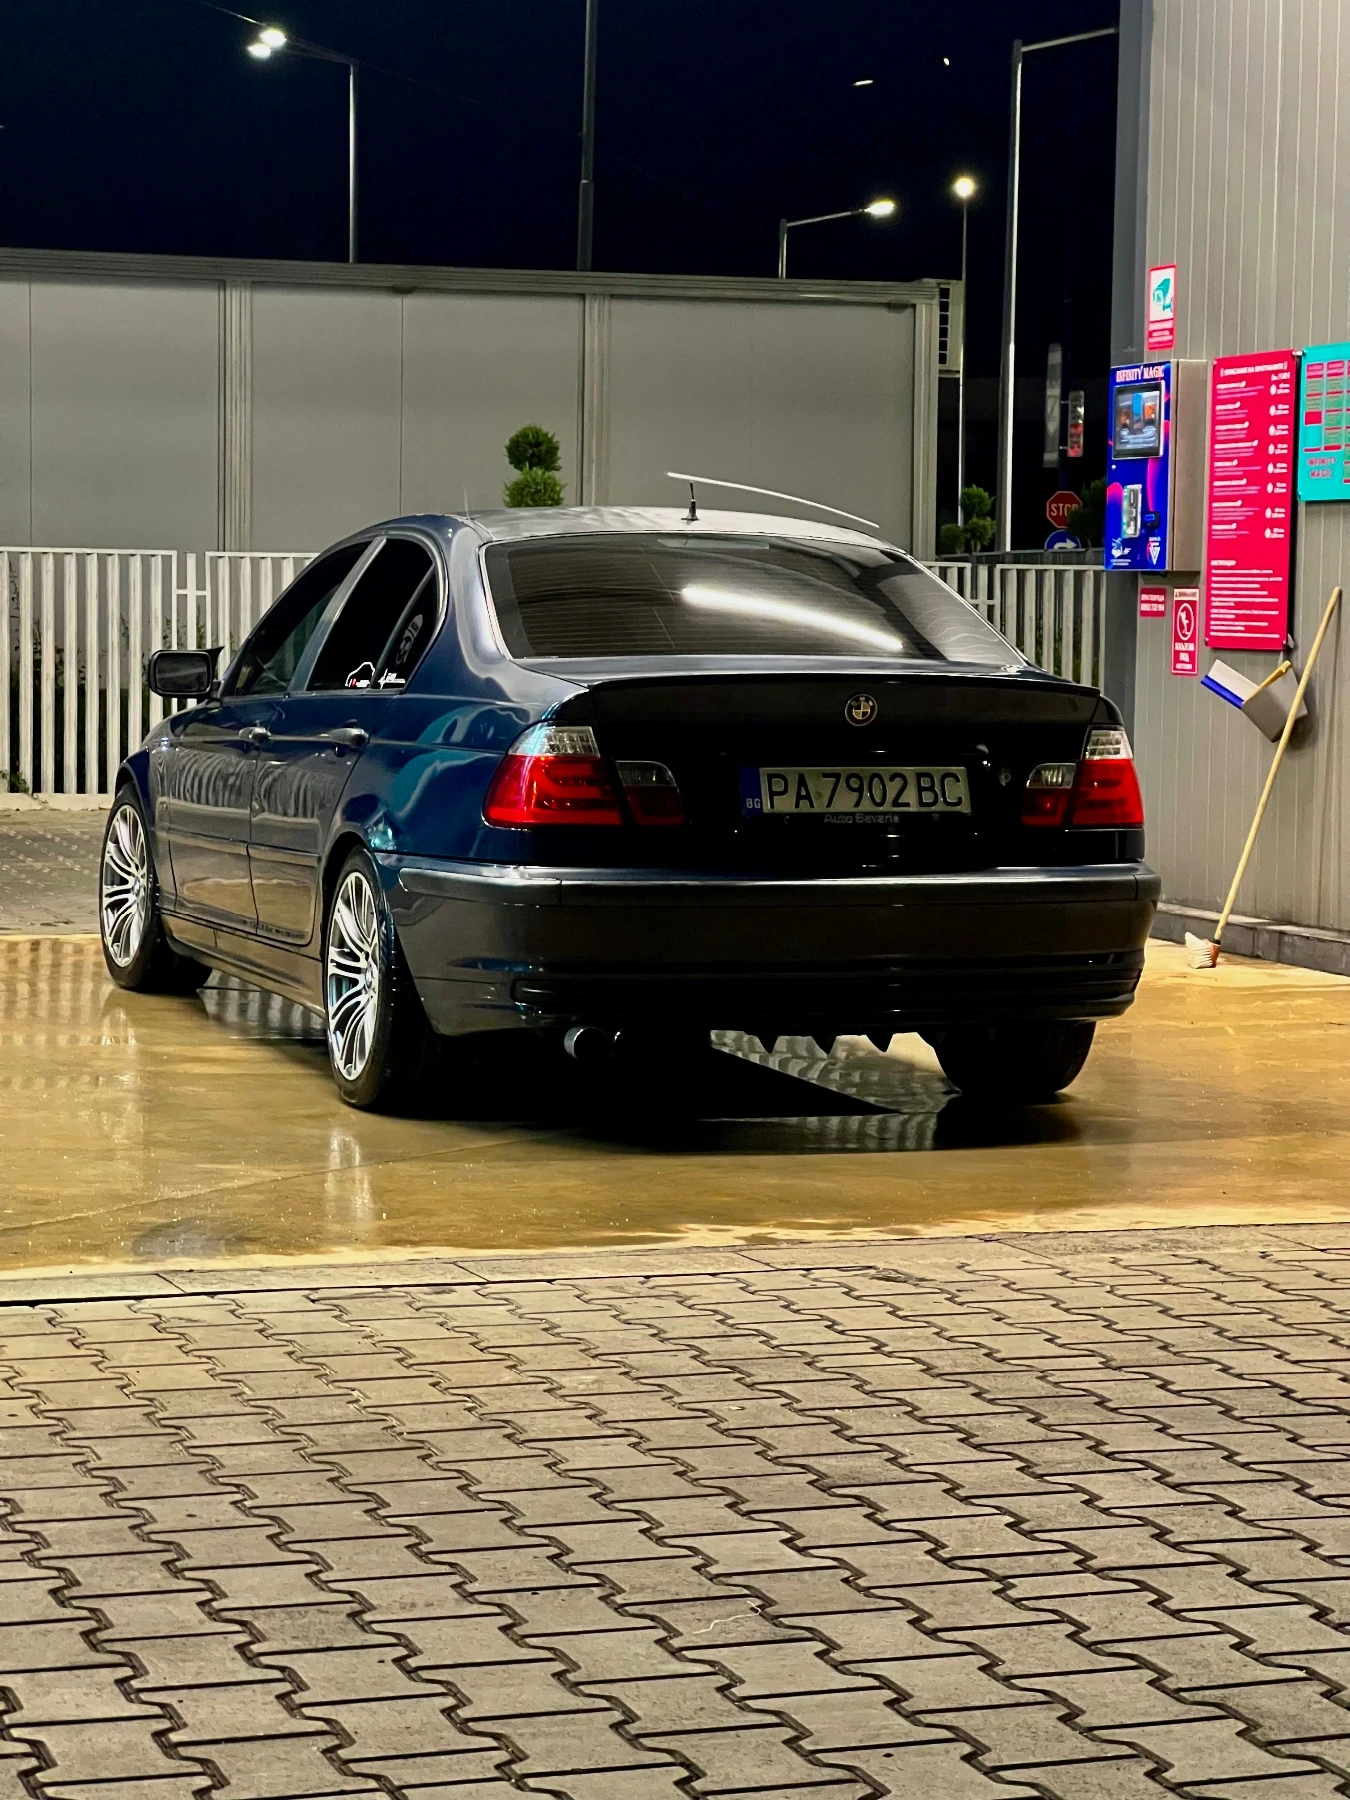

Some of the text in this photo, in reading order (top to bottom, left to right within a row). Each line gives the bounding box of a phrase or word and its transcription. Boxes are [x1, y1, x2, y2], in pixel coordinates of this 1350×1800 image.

[1143, 364, 1165, 379] MAGIC
[746, 798, 761, 809] BG
[824, 814, 900, 824] Auto Bavaria
